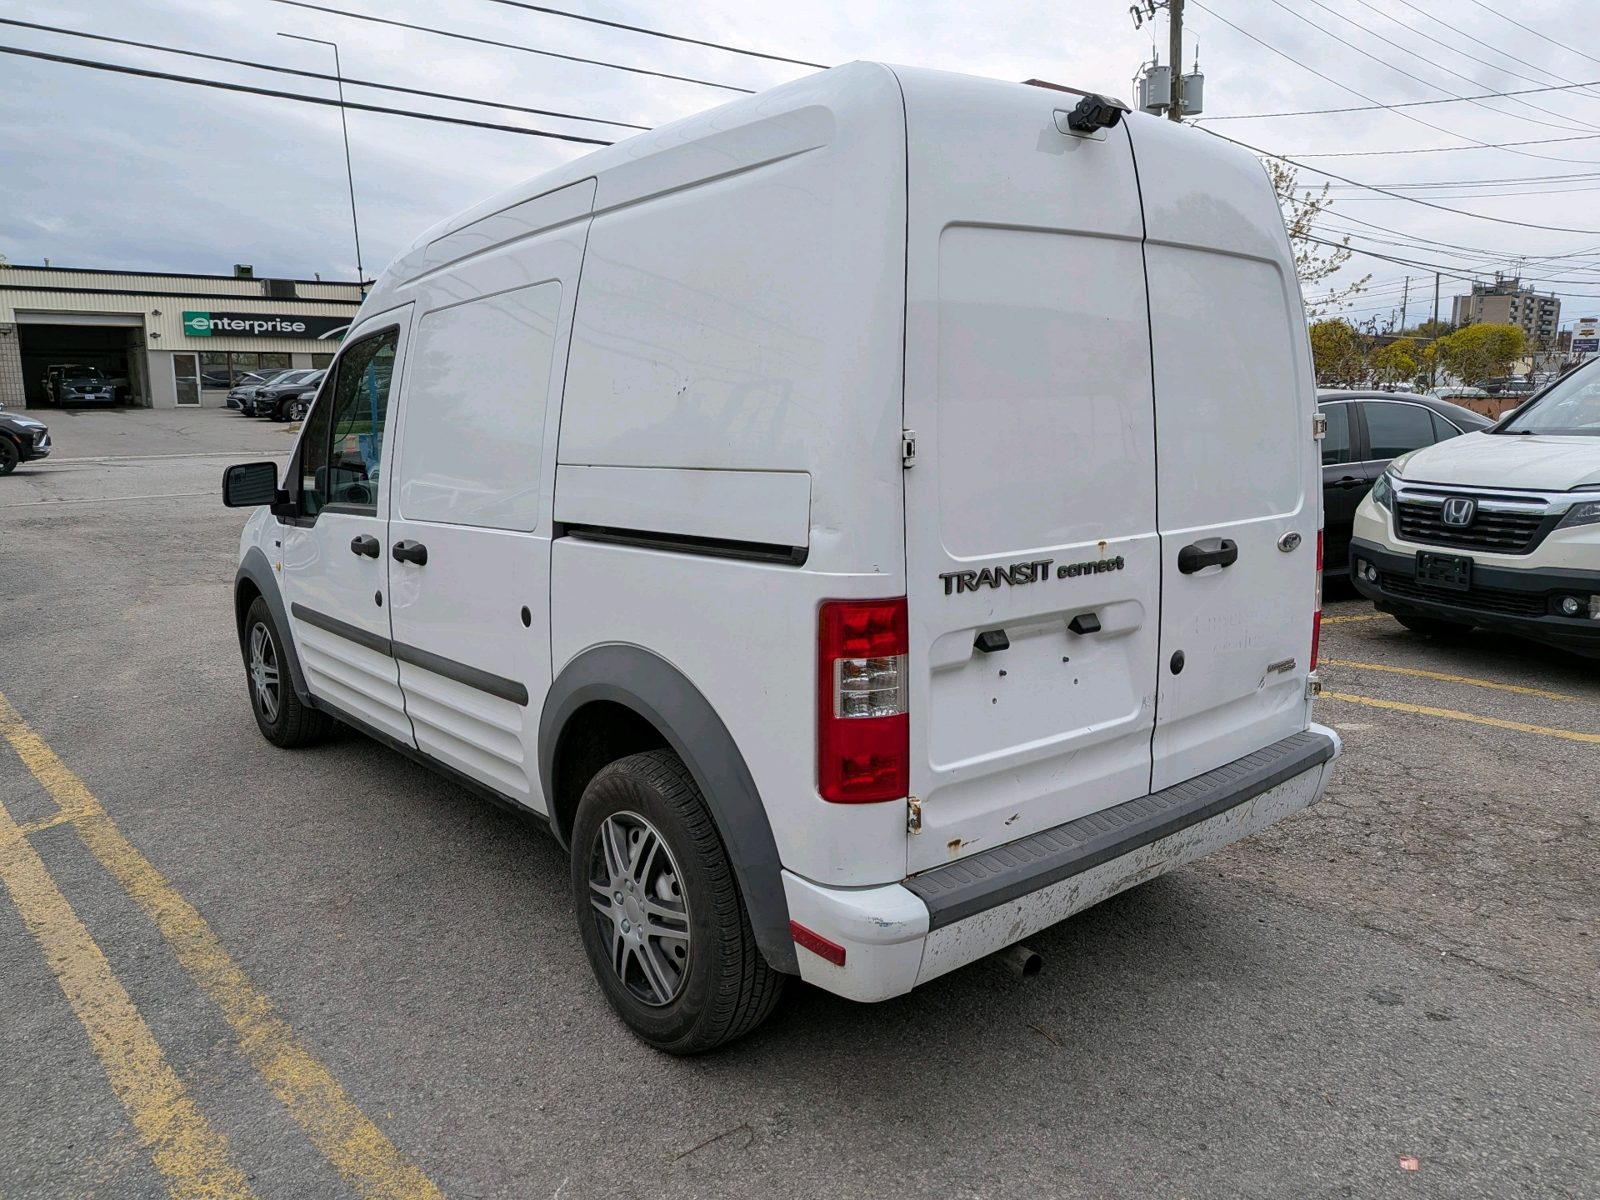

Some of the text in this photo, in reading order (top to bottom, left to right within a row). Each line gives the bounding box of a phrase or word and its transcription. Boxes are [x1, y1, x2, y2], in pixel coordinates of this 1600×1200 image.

[192, 317, 306, 334] enterprise
[938, 555, 1125, 595] TRANSIT connect
